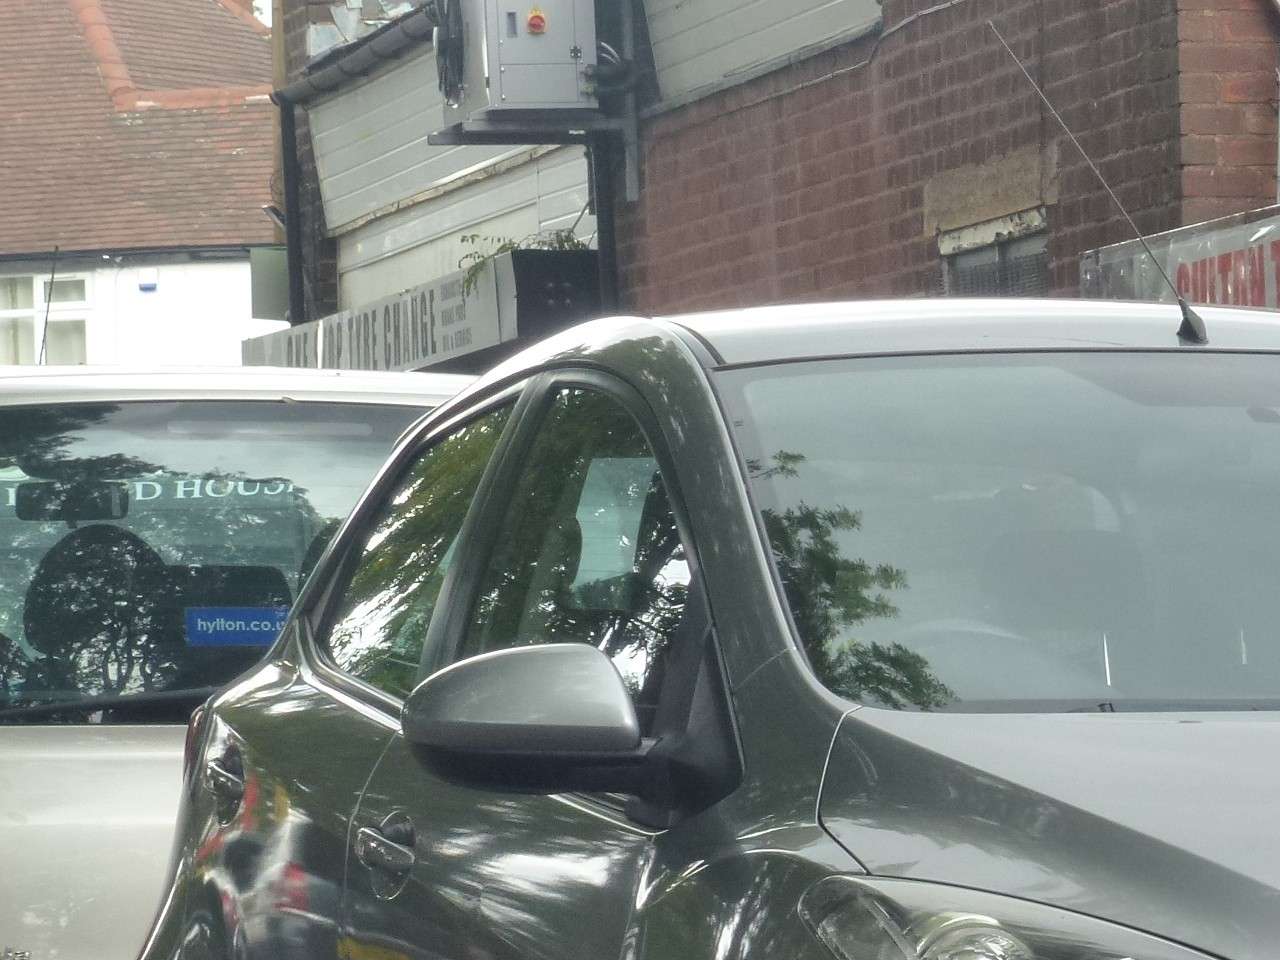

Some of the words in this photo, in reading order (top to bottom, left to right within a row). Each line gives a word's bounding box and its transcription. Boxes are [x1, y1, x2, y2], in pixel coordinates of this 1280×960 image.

[347, 309, 377, 371] TYRE
[383, 288, 437, 371] CHANGE
[176, 478, 294, 500] HOUS
[197, 618, 288, 634] hylton.co.u
